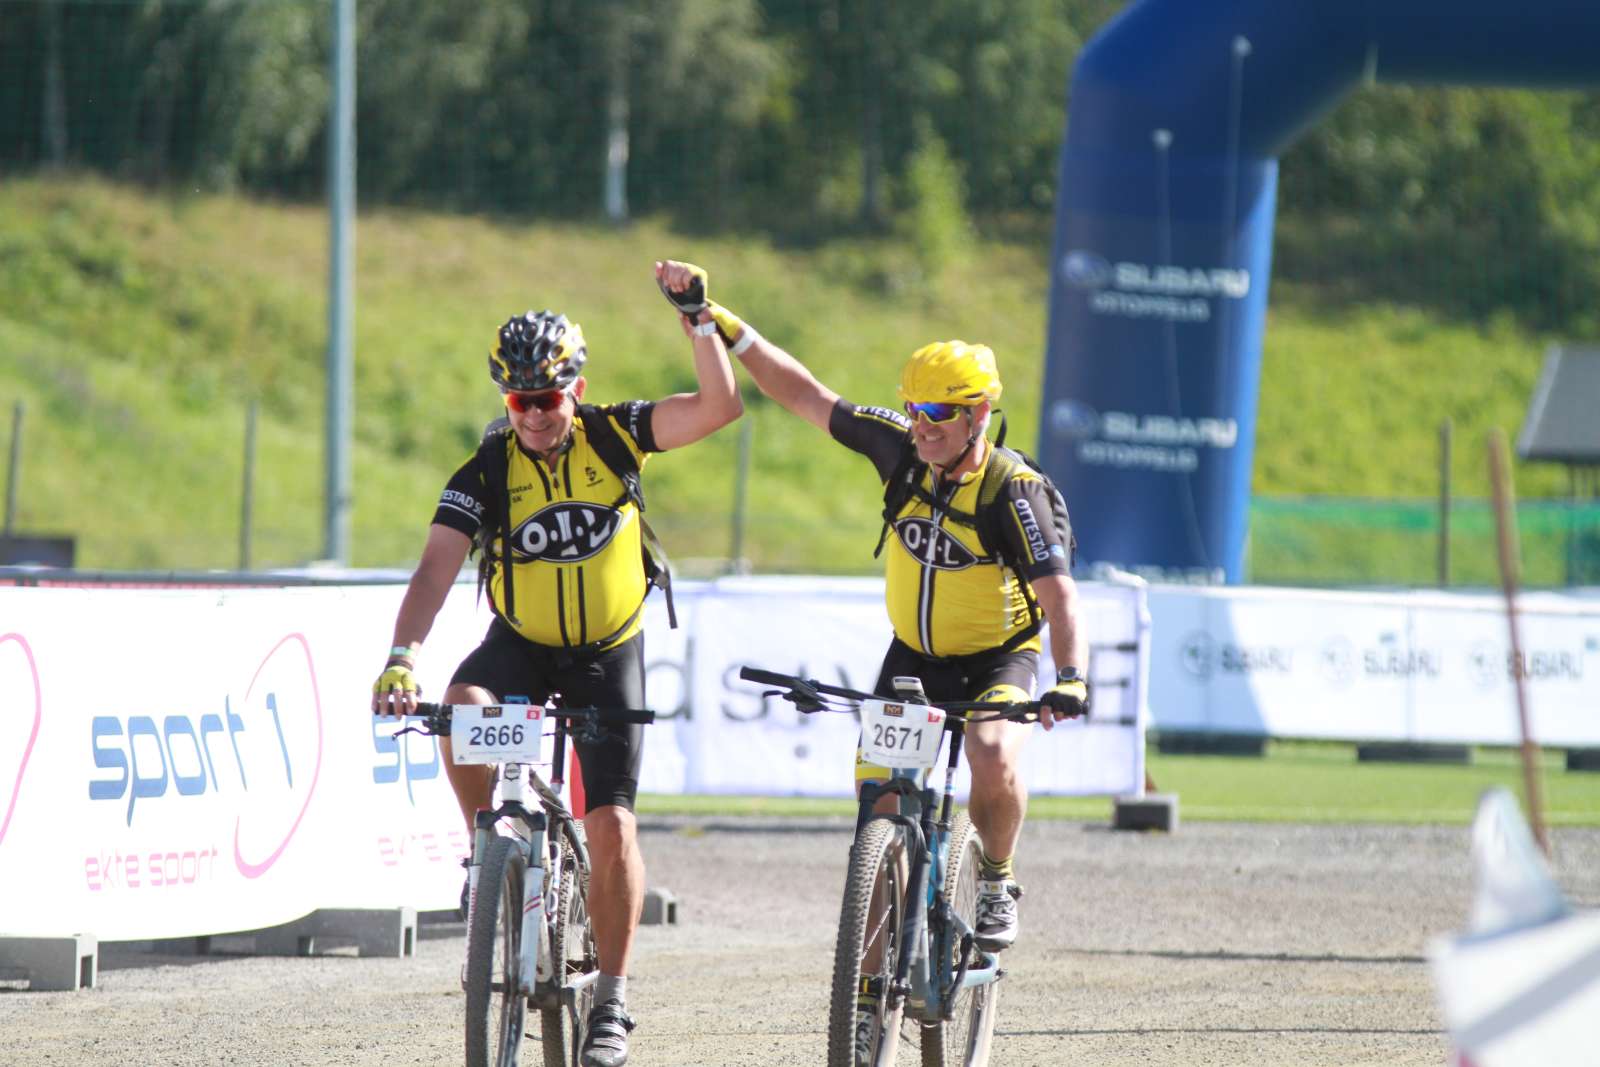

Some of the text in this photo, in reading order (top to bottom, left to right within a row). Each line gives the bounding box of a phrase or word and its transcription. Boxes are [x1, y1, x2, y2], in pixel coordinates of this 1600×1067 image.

[1115, 262, 1250, 298] SUBARU
[1103, 412, 1237, 448] SUBARU
[442, 489, 474, 508] ESTAD
[1015, 499, 1049, 561] OTTESTAD
[469, 724, 524, 746] 2666
[873, 723, 923, 751] 2671
[88, 694, 247, 828] sport
[266, 692, 293, 790] 1
[85, 844, 218, 891] ekte sport
